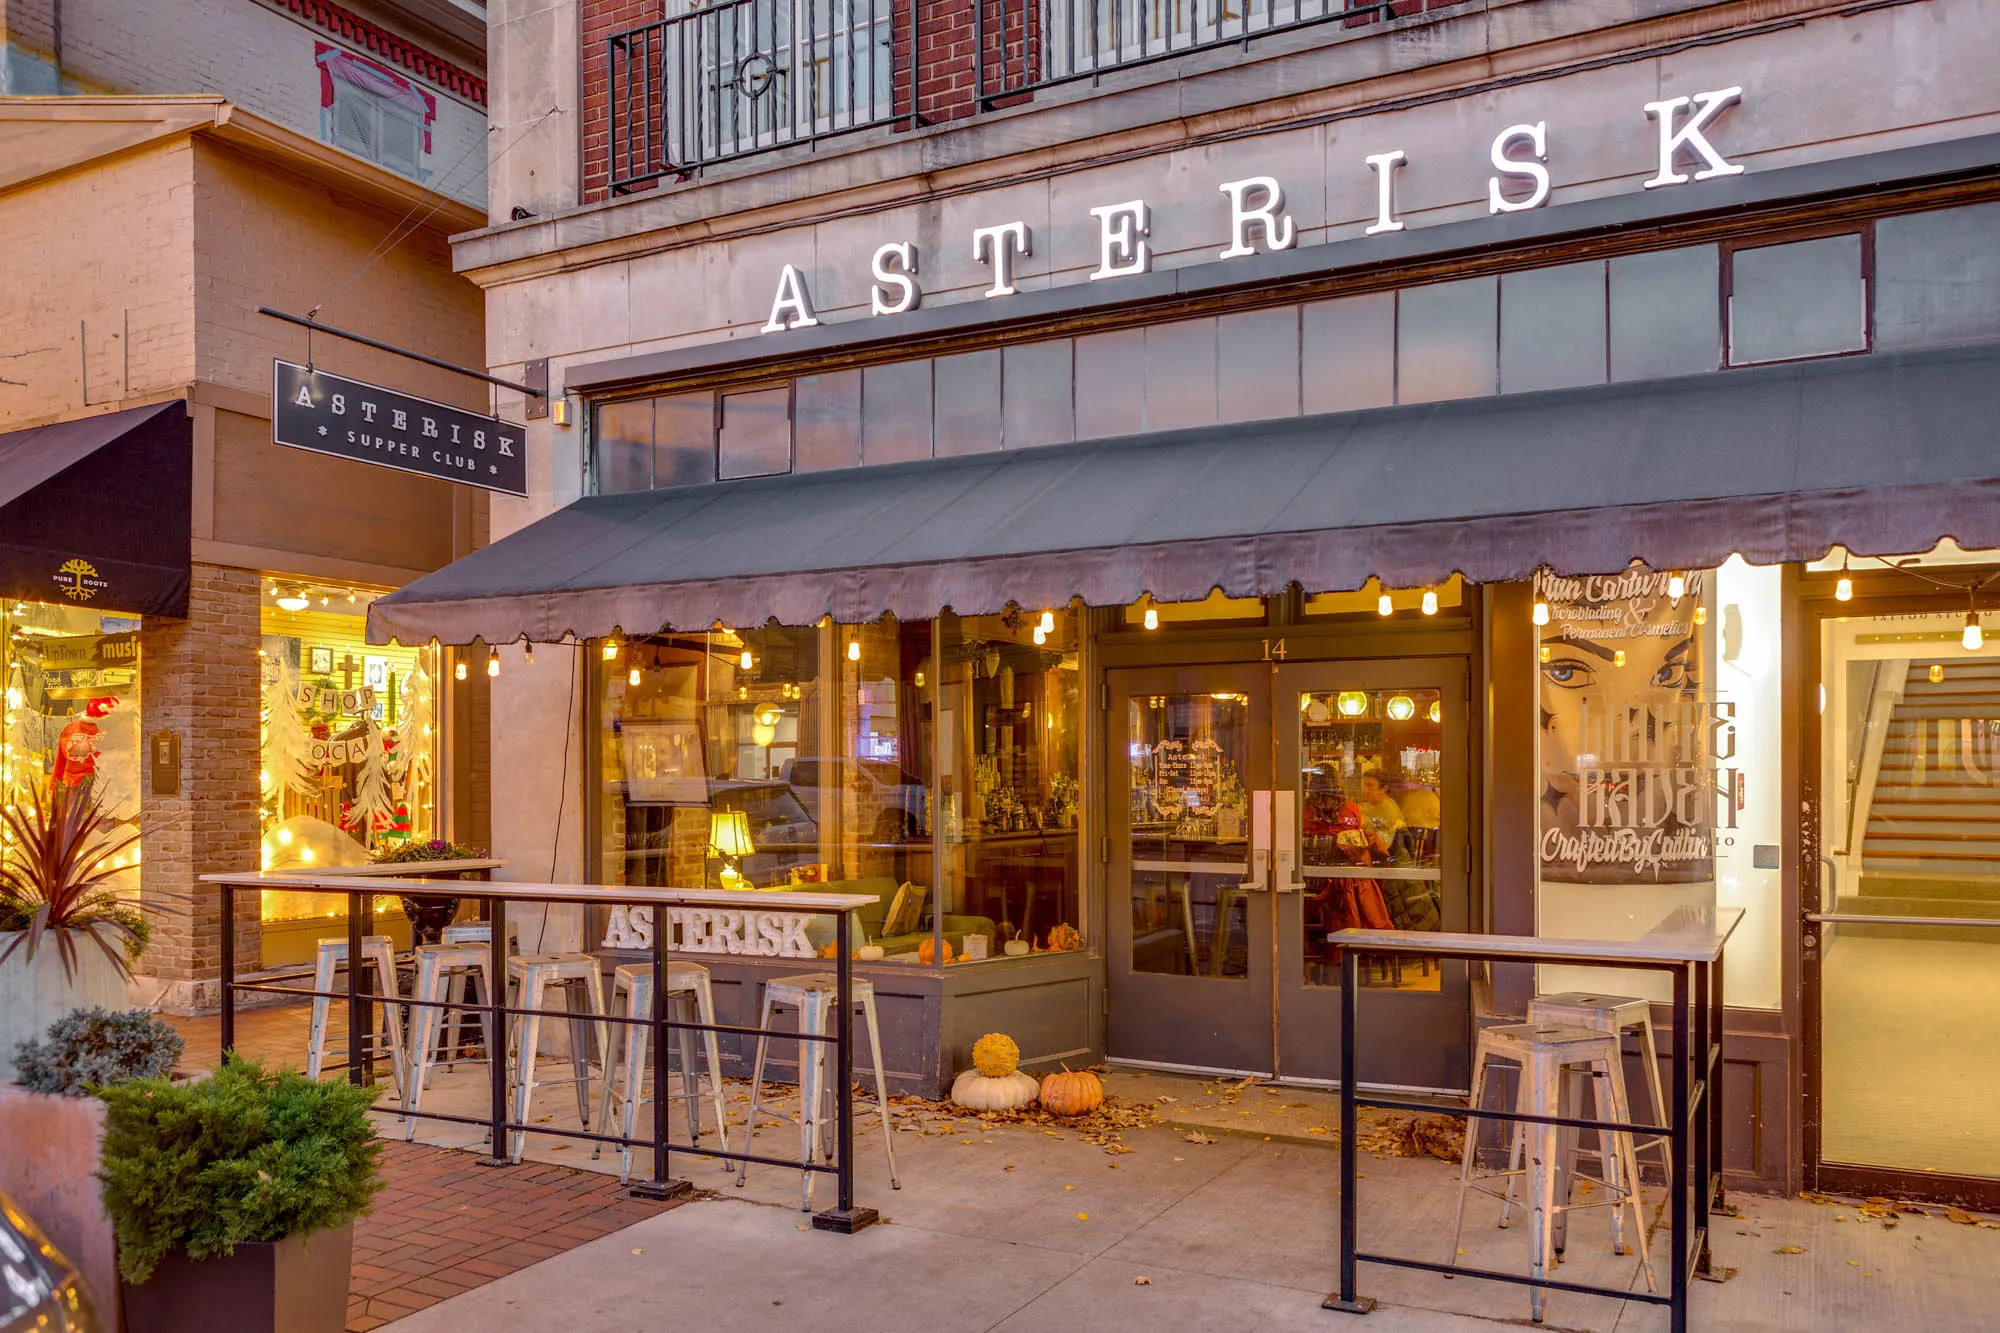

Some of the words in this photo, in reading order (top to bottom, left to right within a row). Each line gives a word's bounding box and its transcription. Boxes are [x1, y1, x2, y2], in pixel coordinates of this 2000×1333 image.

[760, 85, 1744, 333] ASTERISK
[294, 384, 515, 457] ASTERISK
[347, 430, 420, 458] SUPPER
[432, 450, 476, 471] CLUB
[52, 575, 73, 583] PURE
[83, 579, 108, 588] ROOTS
[1551, 605, 1622, 625] icroblading
[102, 636, 138, 658] musi
[1261, 638, 1287, 661] 14
[301, 687, 373, 709] SHOP
[311, 743, 365, 760] OCA
